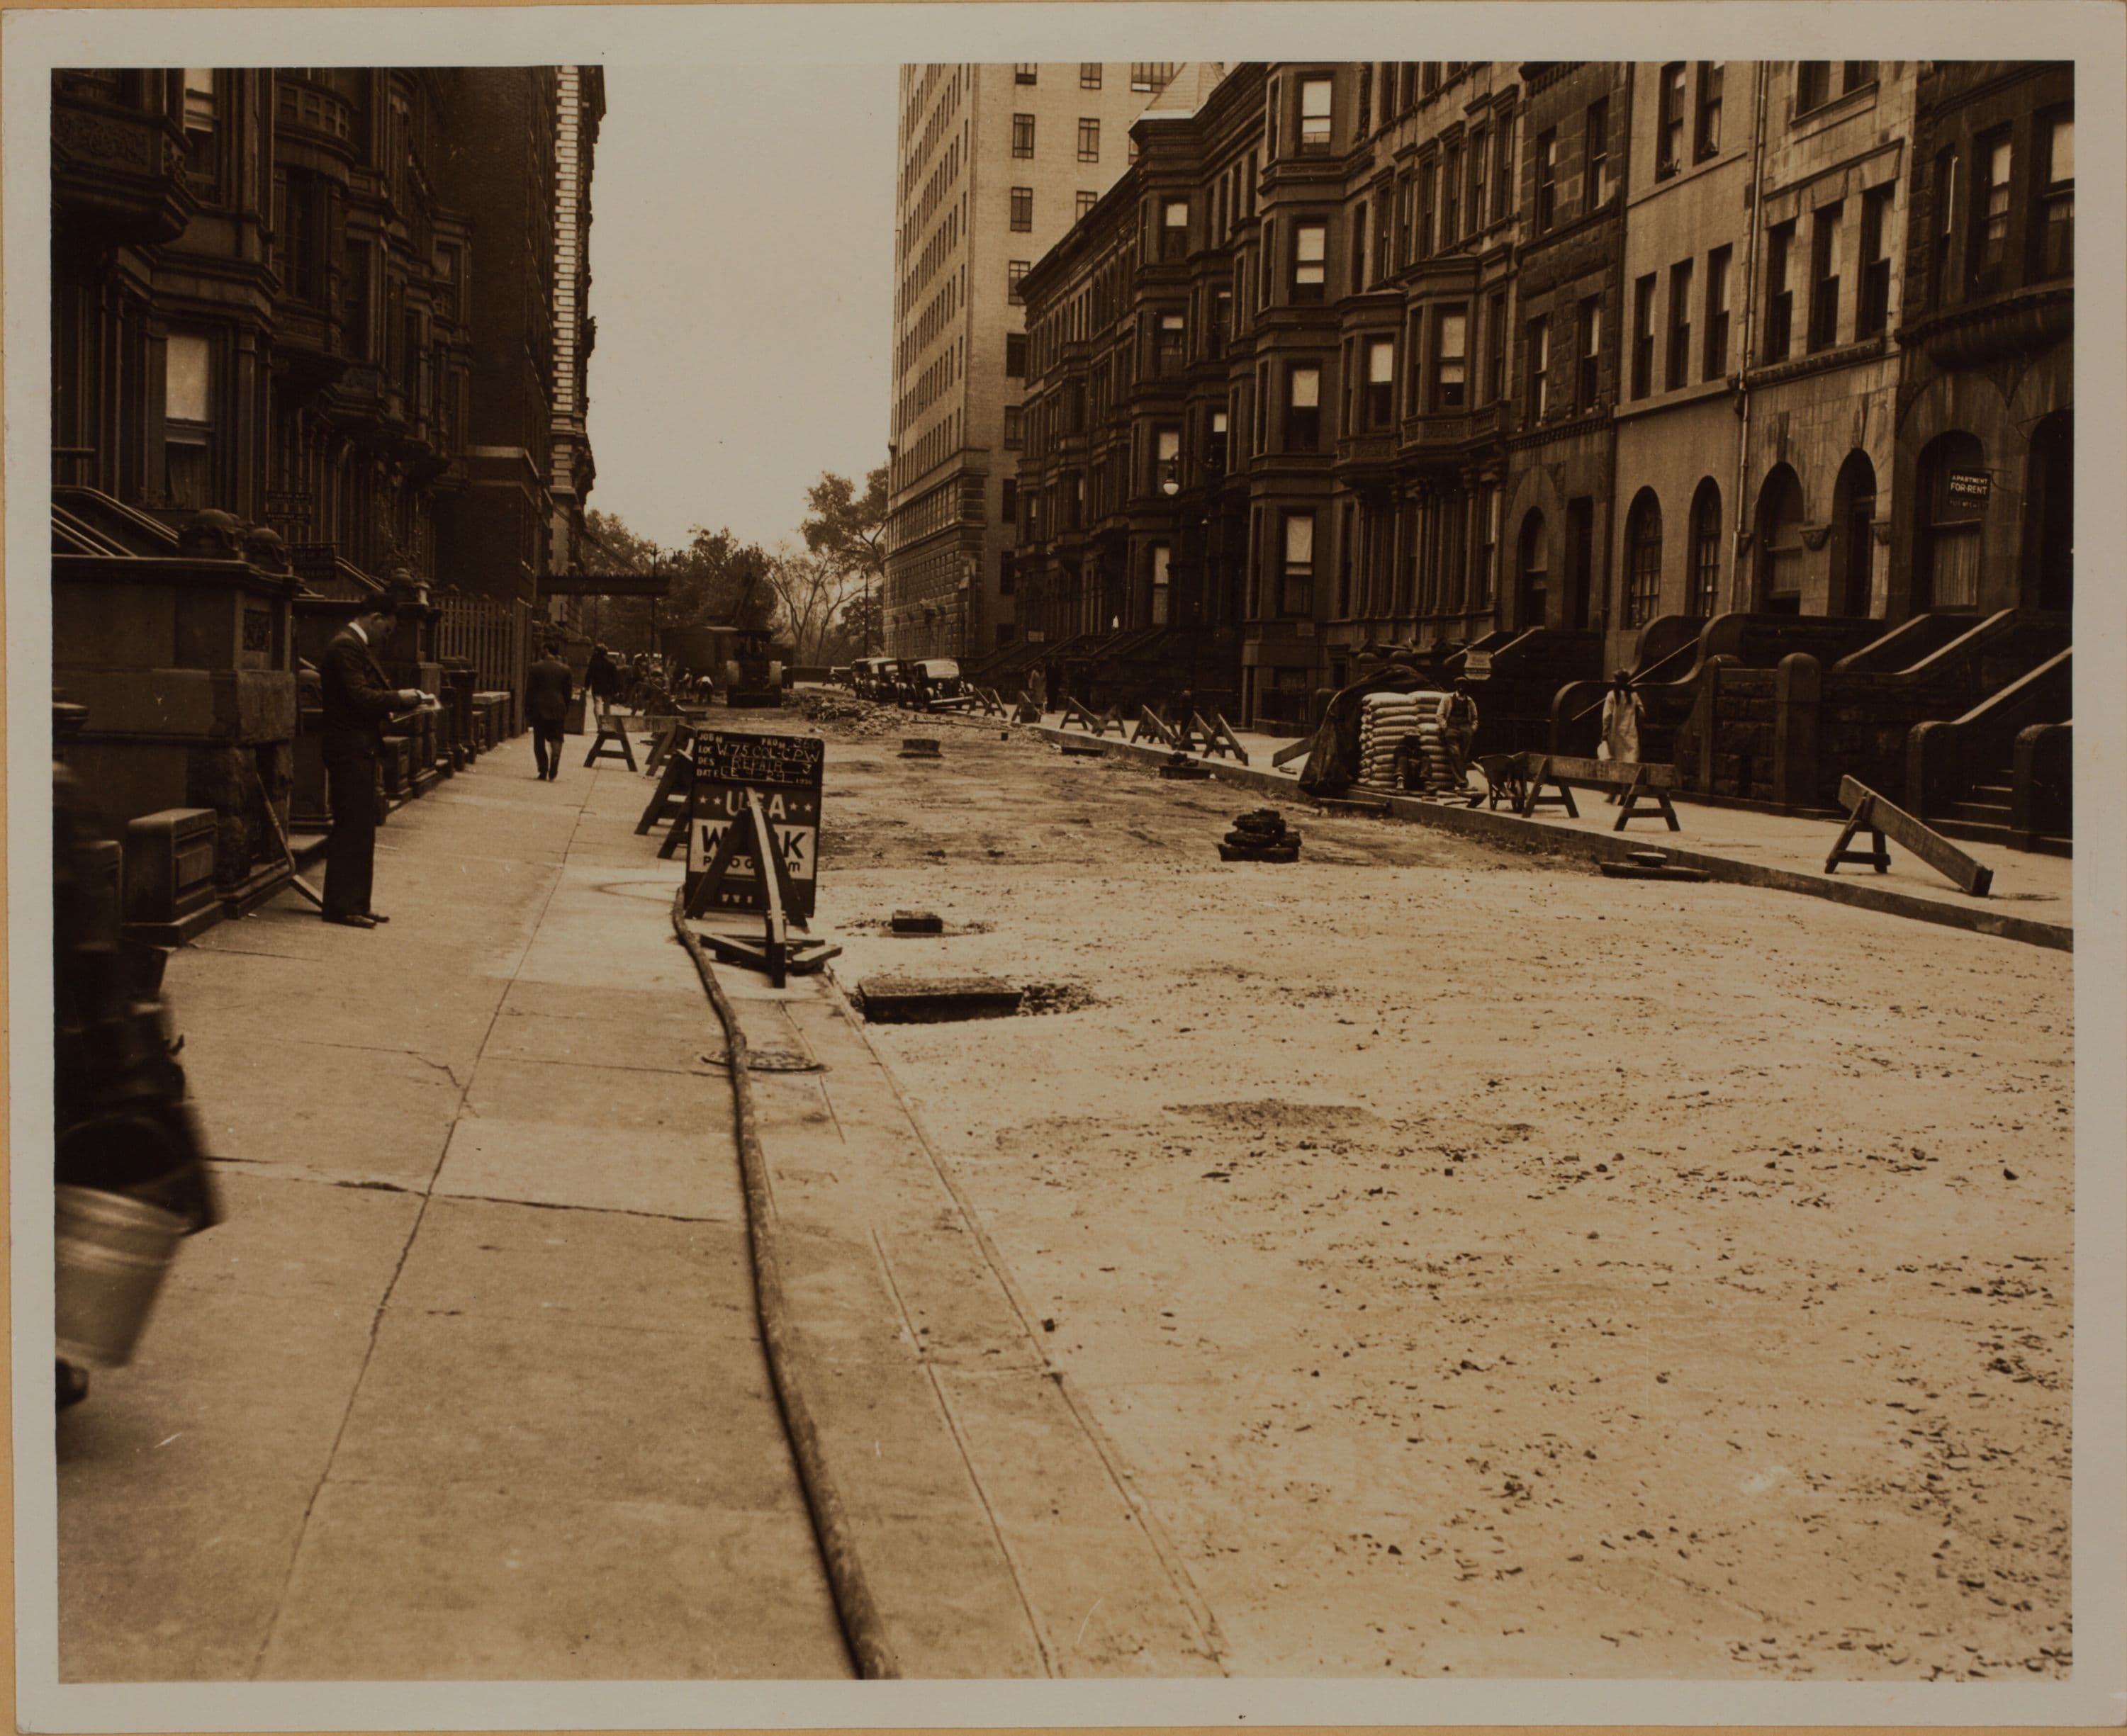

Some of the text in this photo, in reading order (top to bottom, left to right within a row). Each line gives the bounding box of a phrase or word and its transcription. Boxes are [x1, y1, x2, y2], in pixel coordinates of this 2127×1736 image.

[1952, 475, 1987, 484] APARTMENT
[1950, 482, 1987, 495] FOR RENT
[699, 733, 714, 743] JOB
[698, 745, 714, 755] LOC
[731, 743, 750, 759] 75
[697, 756, 715, 767] DES
[731, 757, 784, 772] REPAIR
[696, 768, 719, 778] DATE
[701, 825, 807, 859] WK
[702, 856, 802, 873] POGM
